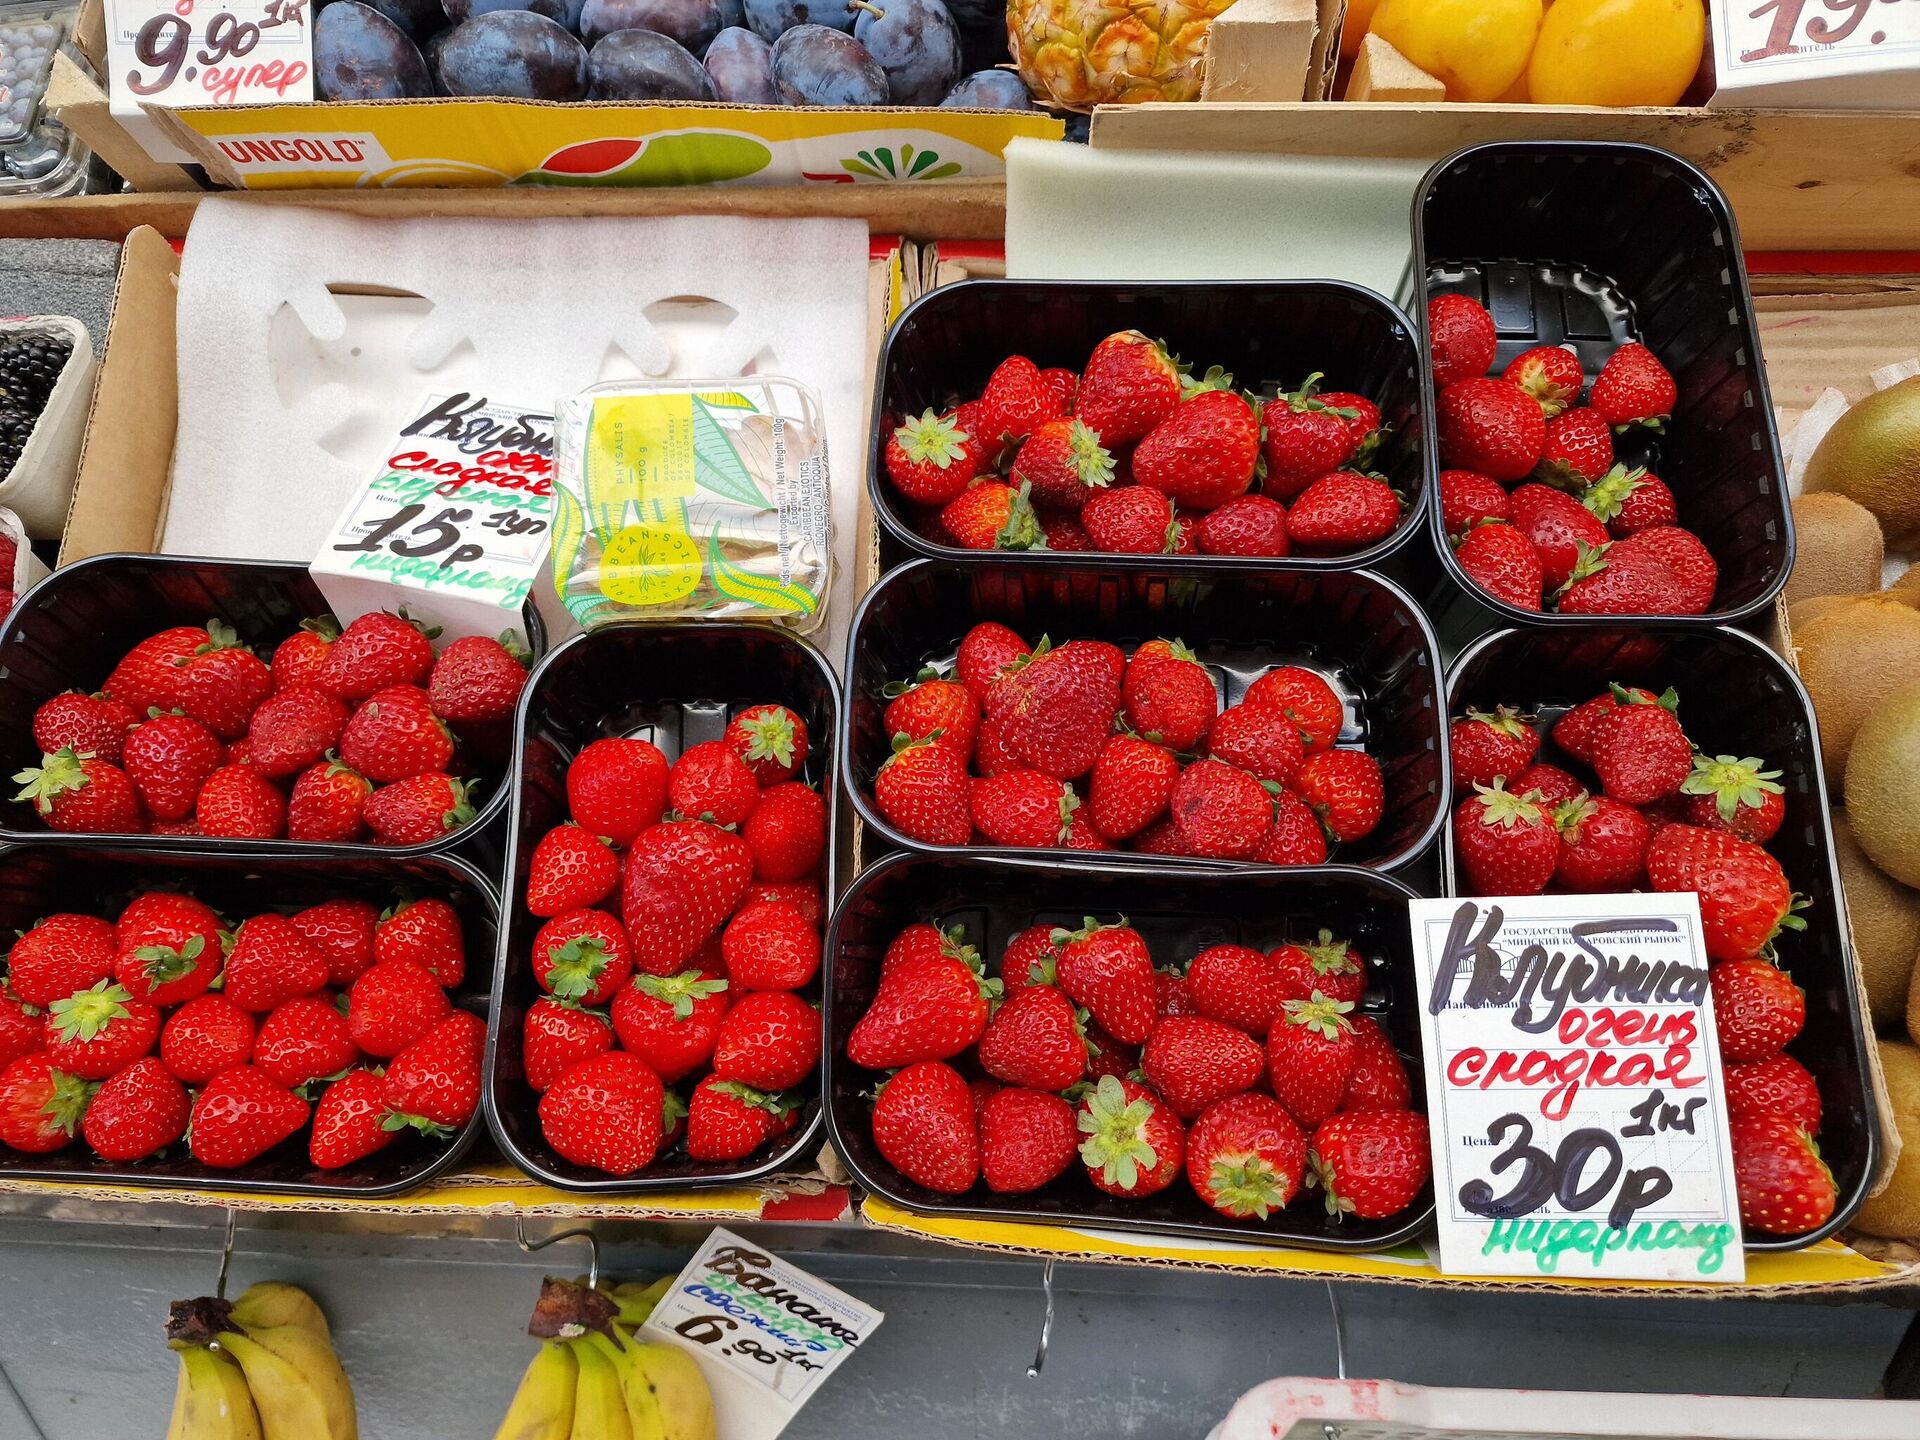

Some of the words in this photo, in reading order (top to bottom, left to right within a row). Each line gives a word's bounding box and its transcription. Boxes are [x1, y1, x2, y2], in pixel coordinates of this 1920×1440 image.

[202, 59, 308, 105] супер
[400, 392, 554, 455] Клубн
[774, 418, 784, 437] 100g
[615, 421, 624, 484] PHYSALIS
[638, 459, 648, 482] 100
[775, 439, 786, 469] Weight:
[776, 471, 785, 485] Net
[789, 480, 799, 489] by
[800, 462, 811, 494] EXOTICS
[812, 457, 822, 498] ANTIOQUIA
[777, 492, 789, 546] Nettogewicht
[789, 491, 799, 525] Exported
[803, 497, 812, 541] CARIBBEAN
[815, 504, 824, 546] RIONEGRO
[1562, 936, 1641, 946] КОАРОВСКИЙ
[1429, 901, 1709, 1034] Клубника
[1620, 1089, 1707, 1138] 1кг
[675, 1315, 778, 1364] 6.90
